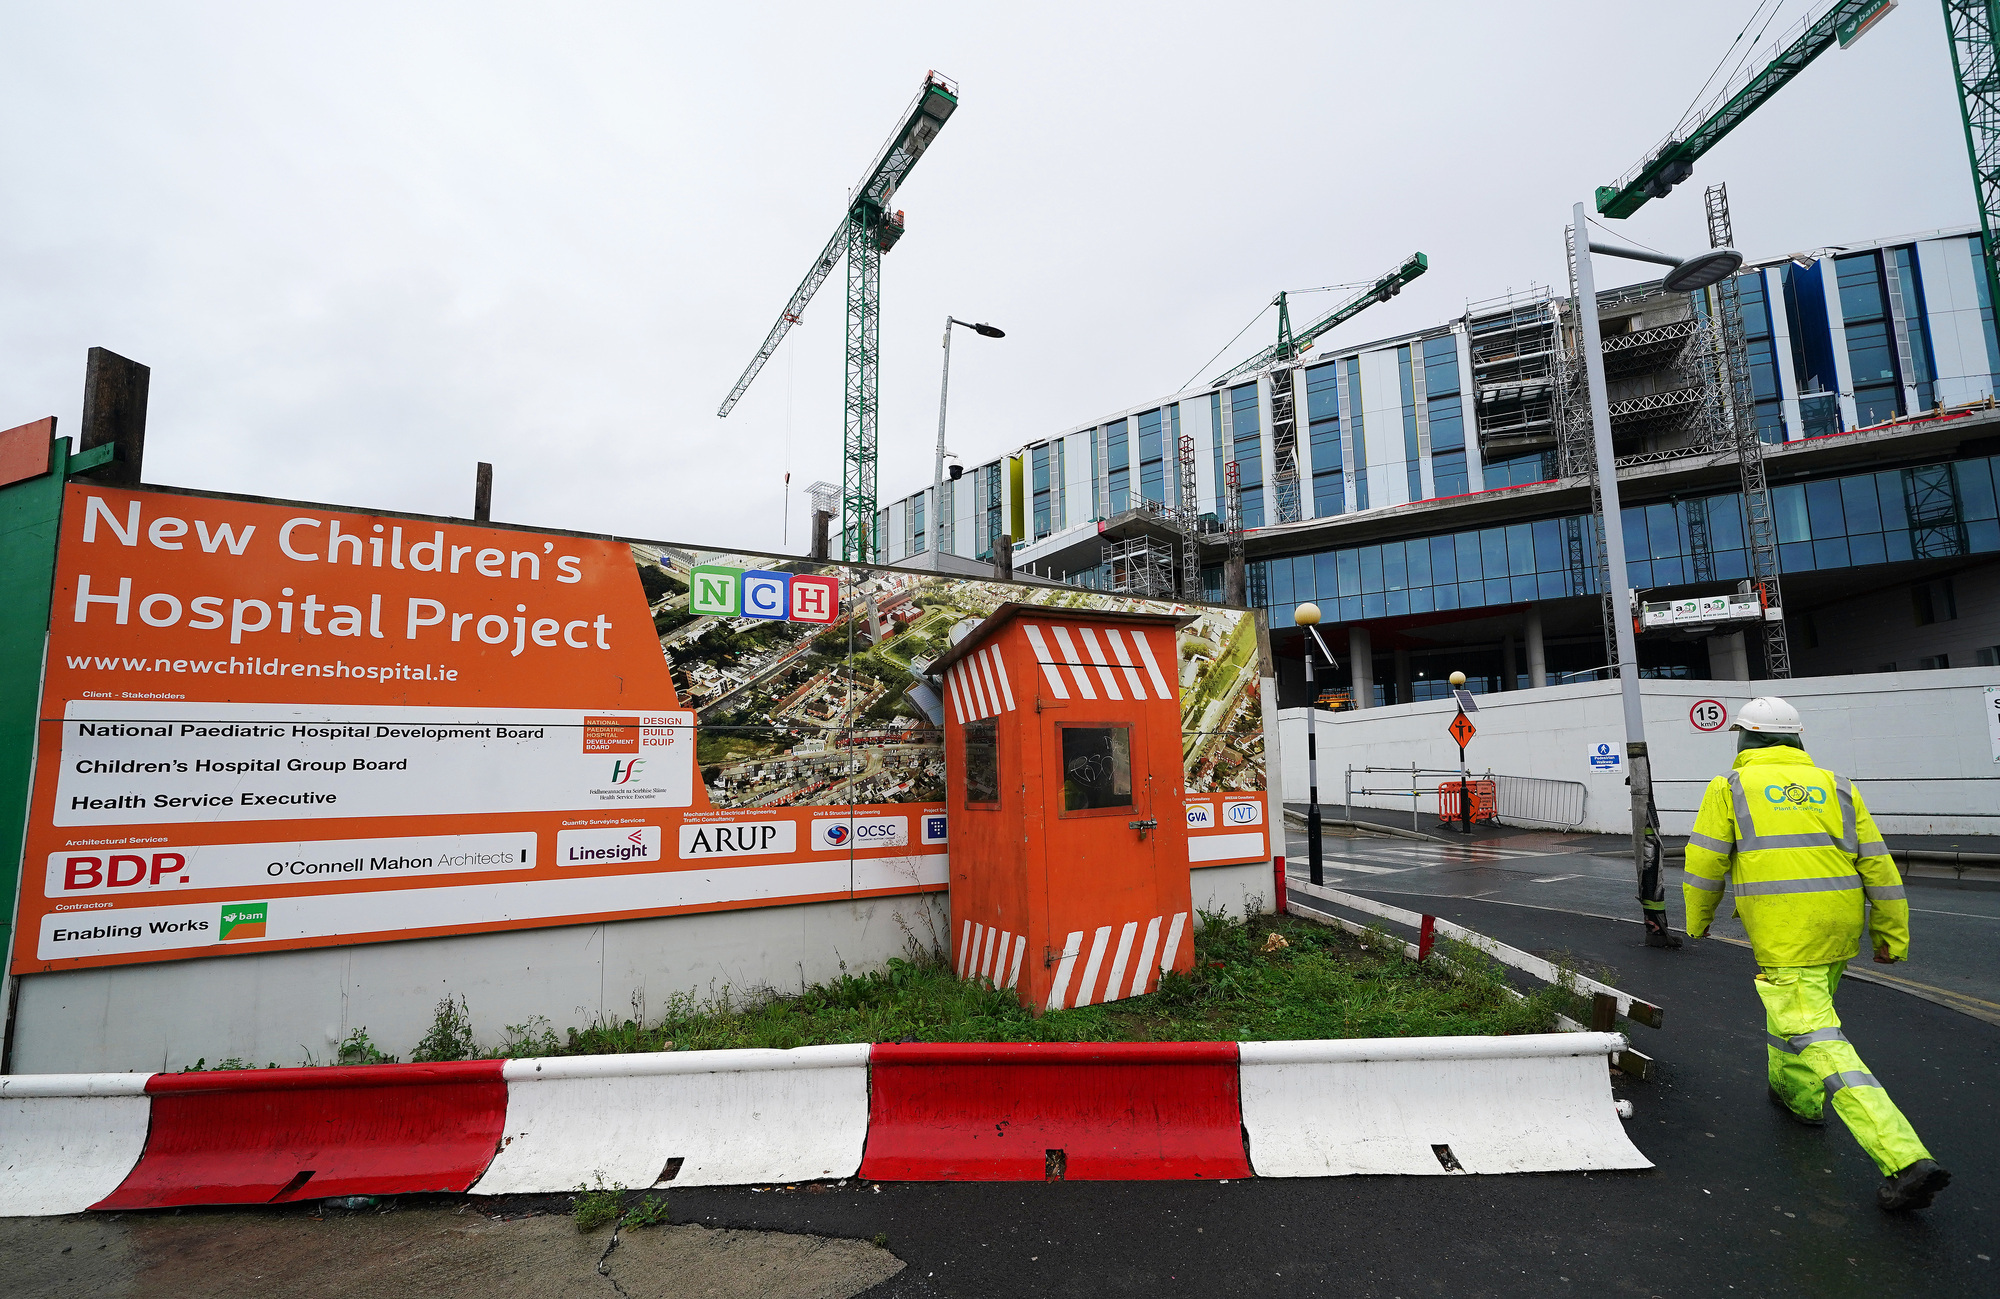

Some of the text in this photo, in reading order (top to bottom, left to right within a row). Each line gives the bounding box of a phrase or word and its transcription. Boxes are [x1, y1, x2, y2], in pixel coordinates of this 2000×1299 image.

[1859, 0, 1881, 22] bam
[82, 496, 582, 584] New Children’s
[74, 574, 612, 657] Hospital Project
[66, 655, 458, 683] www.newchildrenshospital.ie
[82, 691, 112, 699] Client
[122, 691, 185, 700] Stakeholders
[643, 717, 682, 725] DESIGN
[1696, 706, 1718, 720] 15
[79, 723, 544, 742] National Paediatric Hospital Development Board
[643, 728, 674, 736] BUILD
[643, 738, 675, 746] EQUIP
[75, 758, 407, 774] Children’s Hospital Group Board
[71, 791, 337, 810] Health Service Executive
[1187, 812, 1207, 822] GVA
[689, 825, 777, 854] ARUP
[857, 824, 896, 838] OCSC
[65, 836, 168, 847] Architectural Services
[569, 844, 647, 861] Linesight
[63, 853, 189, 890] BDP.
[266, 851, 514, 876] O’Connell Mahon Architects
[55, 900, 113, 911] Contractors
[53, 911, 263, 943] Enabling Works bam
